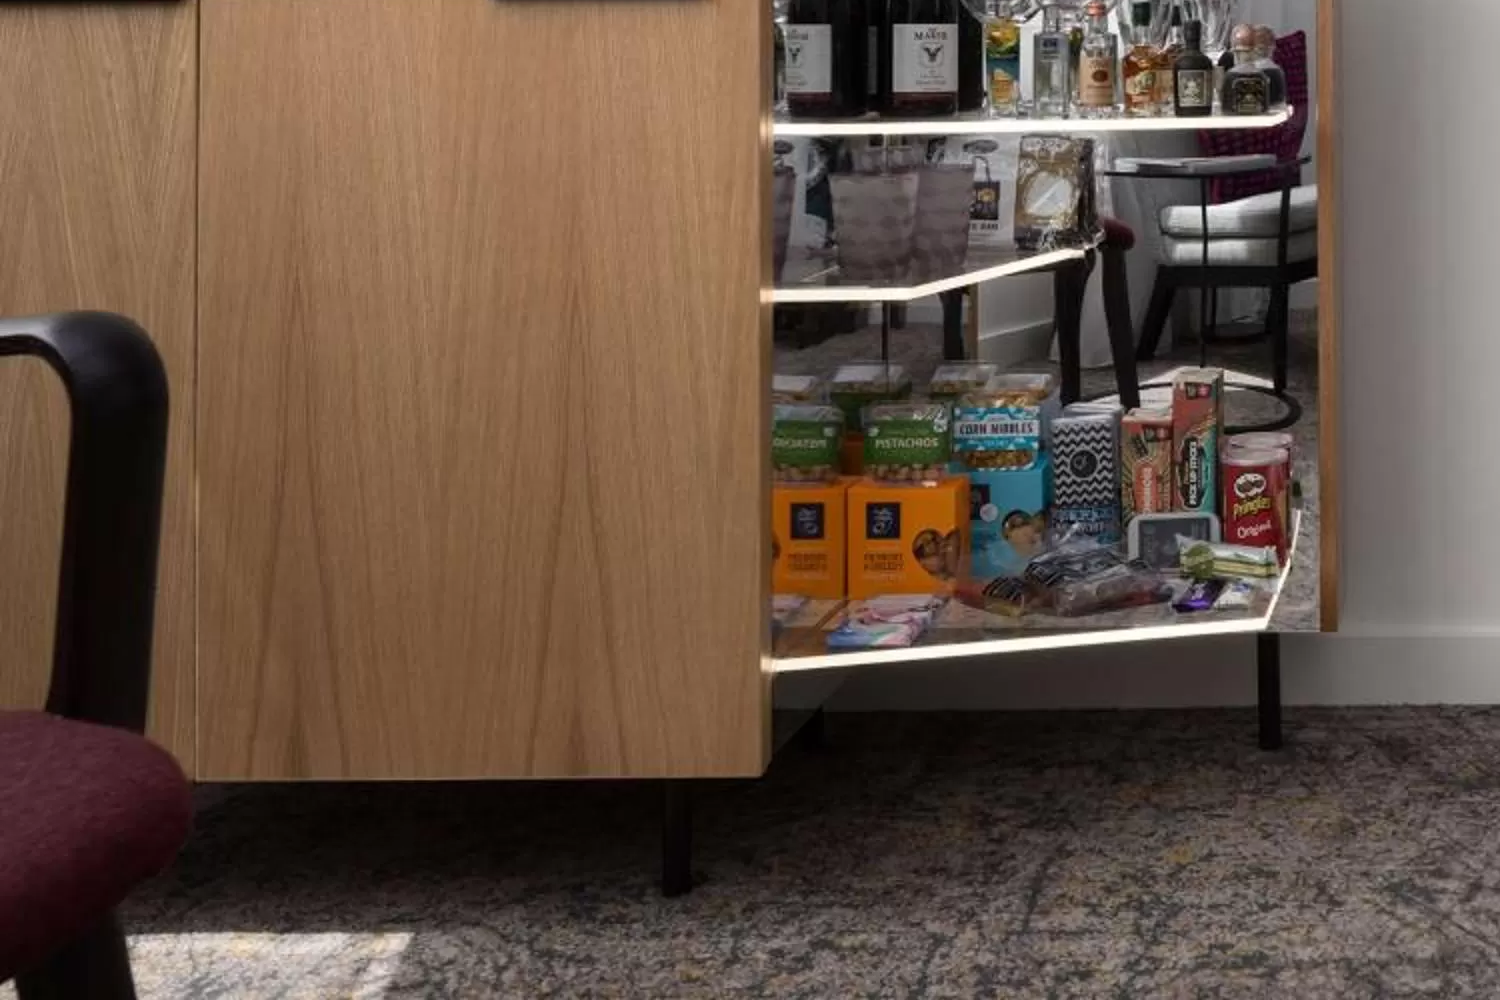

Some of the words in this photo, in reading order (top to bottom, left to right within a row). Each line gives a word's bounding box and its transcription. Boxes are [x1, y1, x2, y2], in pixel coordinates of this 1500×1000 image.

[959, 423, 987, 435] CORN
[991, 422, 1033, 434] NIBBLES
[874, 437, 939, 449] PISTACHIOS
[1233, 496, 1271, 520] Pringles
[1237, 520, 1272, 538] Original
